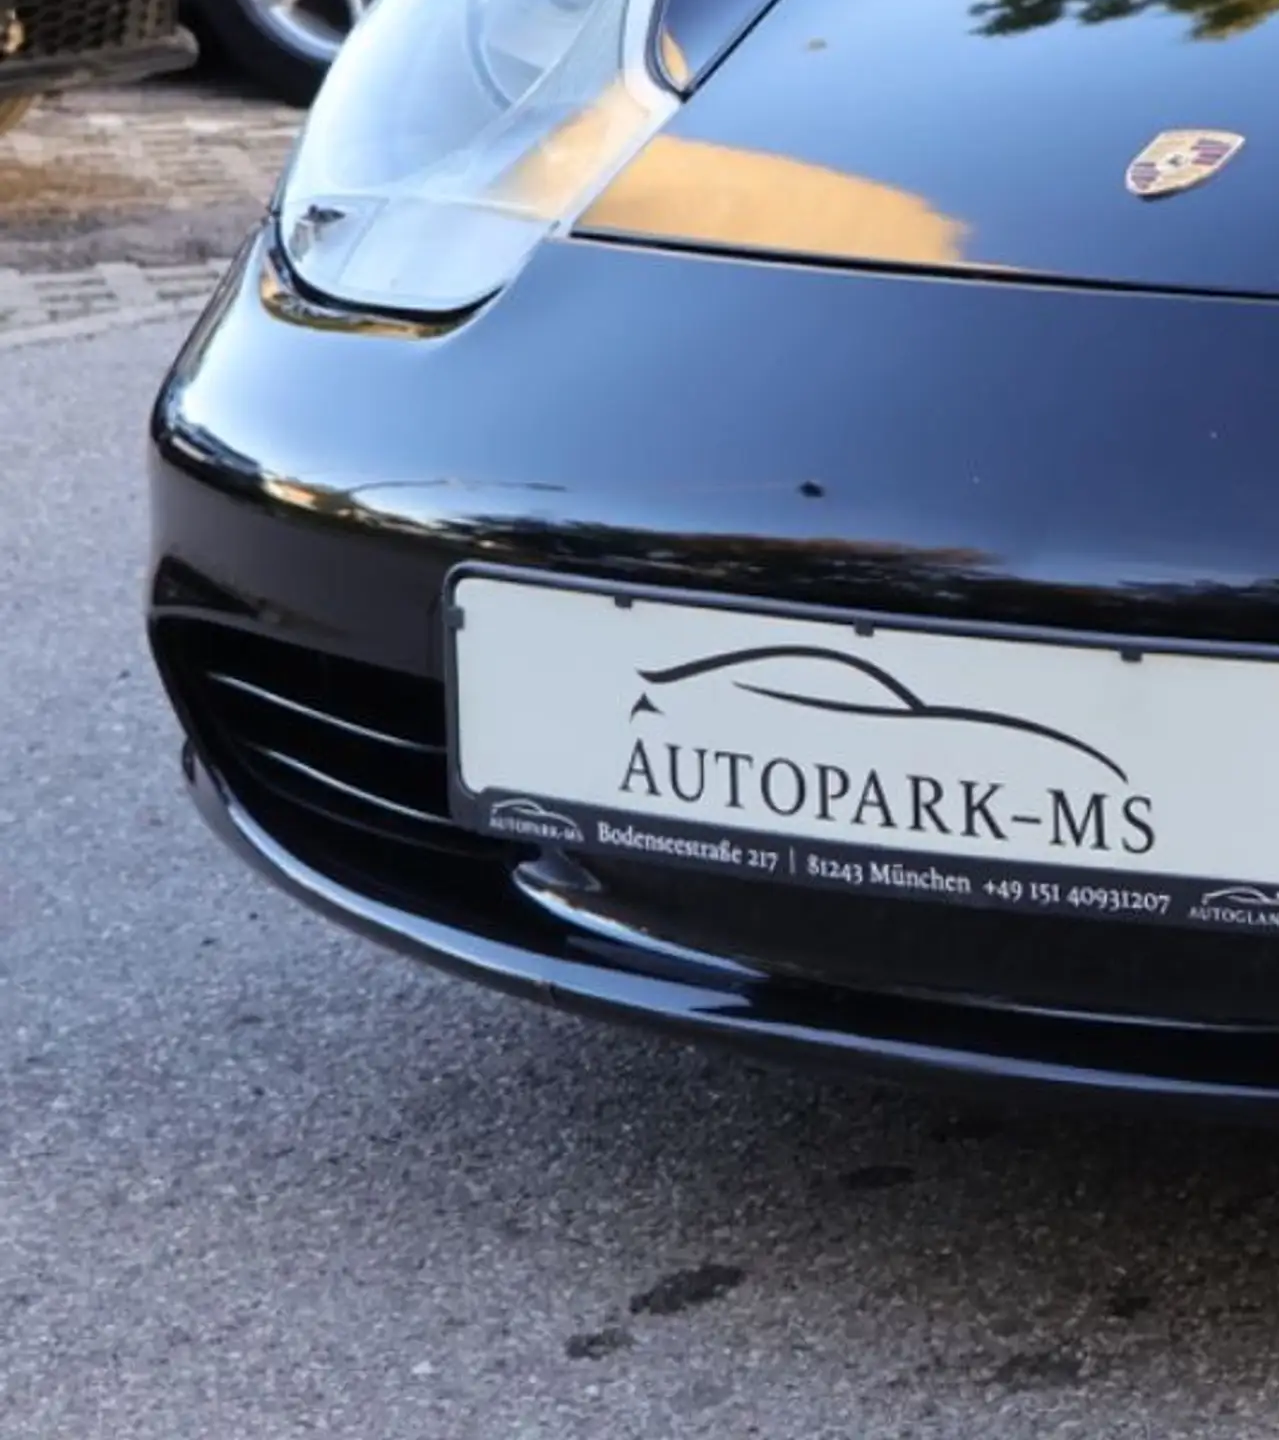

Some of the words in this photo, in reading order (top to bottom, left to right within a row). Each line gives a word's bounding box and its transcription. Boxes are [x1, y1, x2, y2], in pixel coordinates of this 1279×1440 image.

[618, 737, 1157, 855] AUTOPARK-MS
[597, 820, 743, 866] Bodenseestraße
[747, 849, 779, 872] 217
[806, 853, 864, 885] 81243
[869, 861, 971, 894] München
[982, 879, 1023, 902] +49
[1030, 882, 1061, 905] 151
[1066, 884, 1172, 915] 40931207
